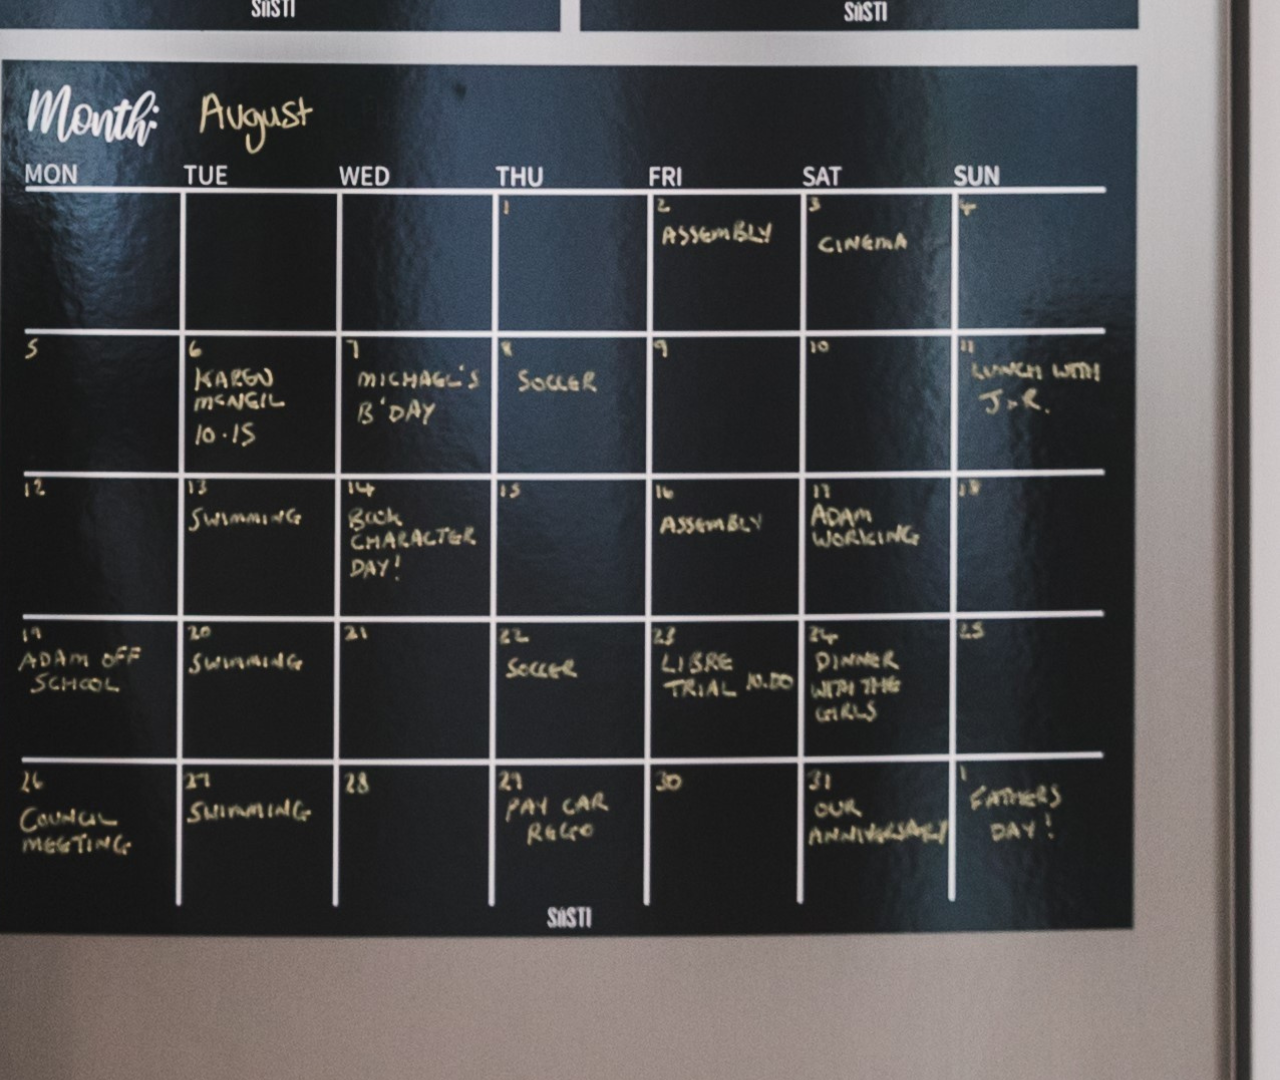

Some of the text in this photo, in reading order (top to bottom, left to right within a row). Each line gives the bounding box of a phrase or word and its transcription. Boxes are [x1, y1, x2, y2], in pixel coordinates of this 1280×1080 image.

[27, 84, 160, 147] Month:
[199, 92, 313, 154] August
[25, 163, 78, 184] MON
[183, 164, 228, 186] TUE
[339, 165, 390, 187] WED
[496, 166, 544, 187] THU
[649, 166, 682, 187] FRI
[802, 166, 843, 187] SAT
[953, 165, 1000, 187] SUN
[808, 196, 821, 213] 3
[817, 232, 908, 254] CINEMA
[189, 340, 203, 358] 6
[346, 340, 359, 359] 7
[652, 339, 669, 358] 9
[809, 339, 830, 354] 10
[194, 367, 274, 392] KAREN
[518, 369, 598, 393] SOCCER
[187, 479, 208, 495] 13
[347, 481, 376, 498] 14
[810, 503, 873, 527] ADAM
[350, 526, 477, 551] CHARACTER
[18, 649, 89, 672] ADAM
[30, 672, 120, 694] SCHOOL
[663, 679, 737, 698] TRIAL
[562, 791, 609, 815] CAR
[814, 798, 862, 819] OUR
